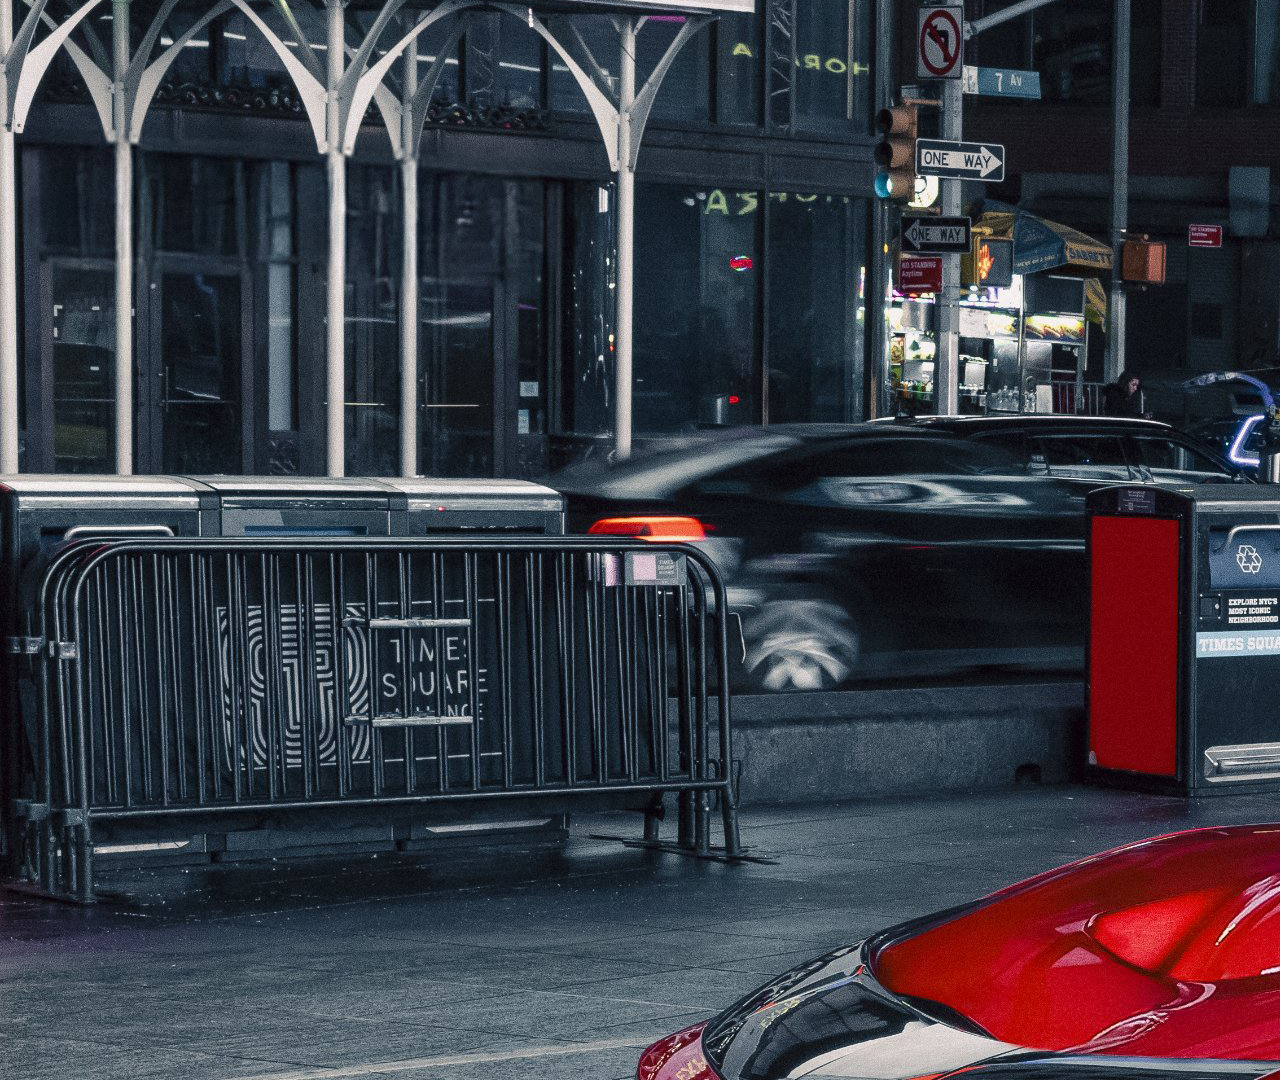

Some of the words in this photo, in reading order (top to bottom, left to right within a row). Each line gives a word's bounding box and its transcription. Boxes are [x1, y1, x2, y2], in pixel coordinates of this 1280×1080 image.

[995, 72, 1003, 92] 7
[1010, 74, 1022, 87] AV
[924, 151, 949, 166] ONE
[964, 153, 992, 168] WAY
[911, 228, 930, 241] ONE
[940, 228, 961, 241] WAY
[911, 261, 936, 269] STANDING
[1199, 637, 1244, 652] TIMES
